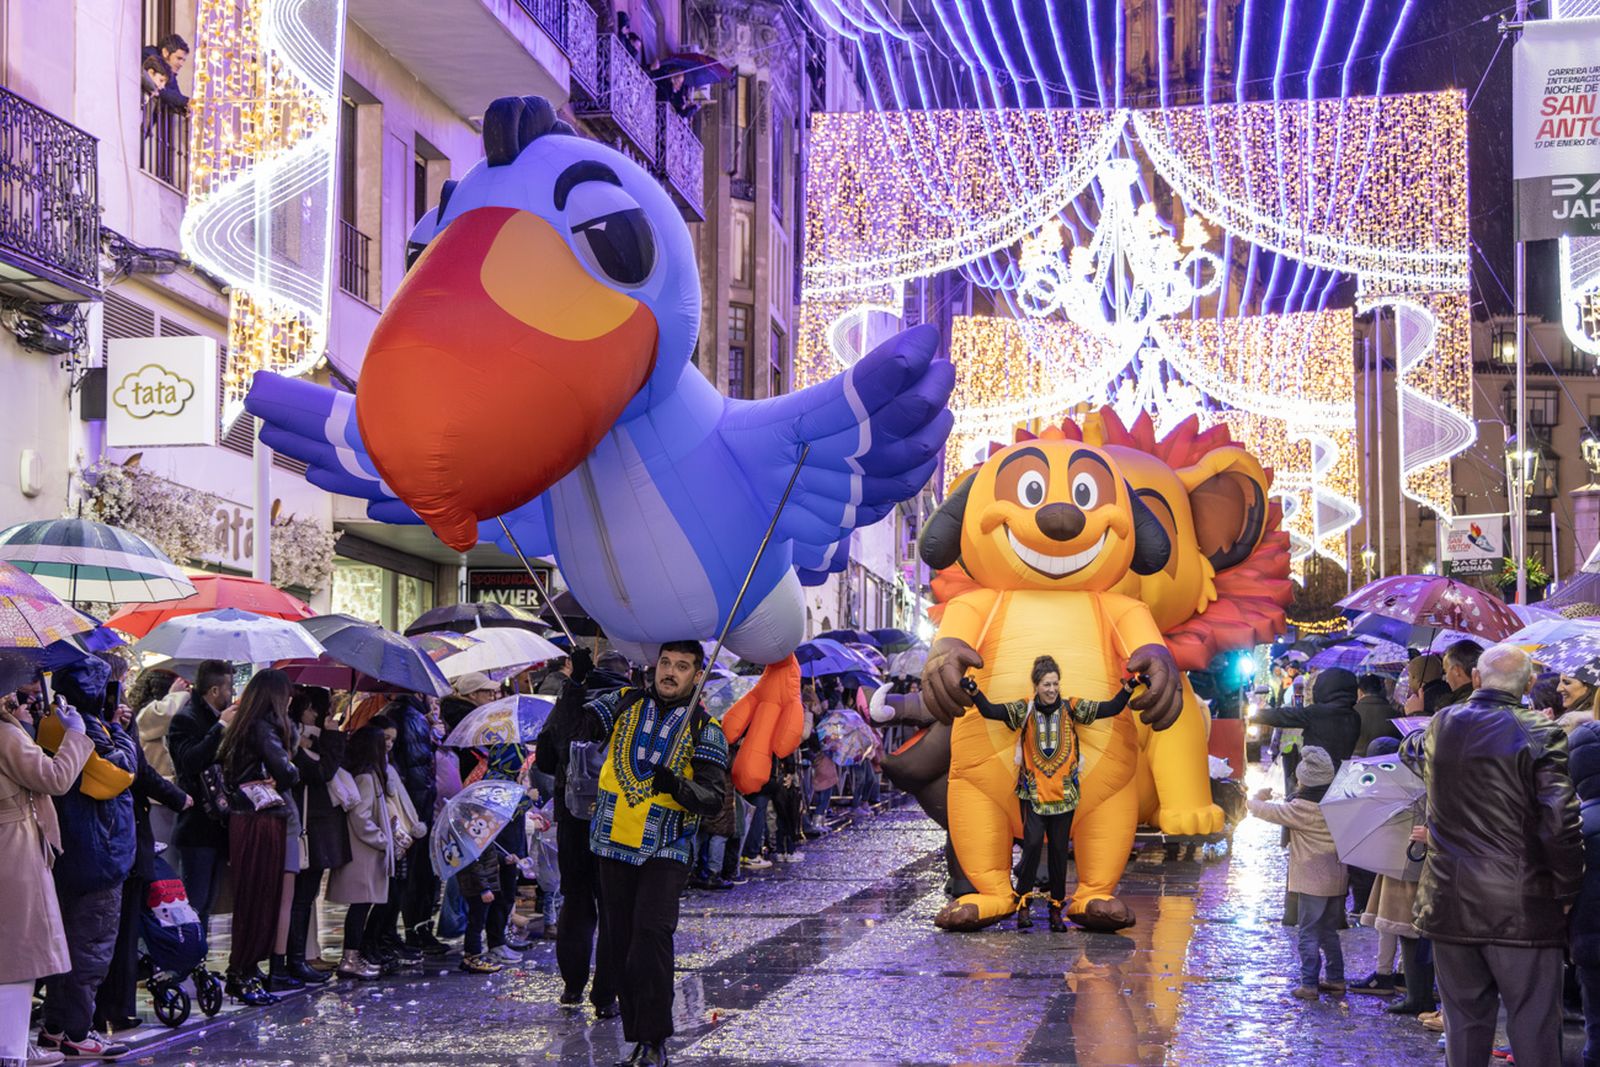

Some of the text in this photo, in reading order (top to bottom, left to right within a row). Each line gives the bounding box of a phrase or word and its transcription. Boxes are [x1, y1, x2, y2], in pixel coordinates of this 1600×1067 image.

[1548, 68, 1587, 76] CARRERA
[1545, 83, 1599, 94] NOCHE DE
[1540, 94, 1597, 116] SAN
[1534, 138, 1598, 149] 17 DE ENERO DE
[132, 382, 177, 405] tata
[477, 589, 539, 606] JAVIER
